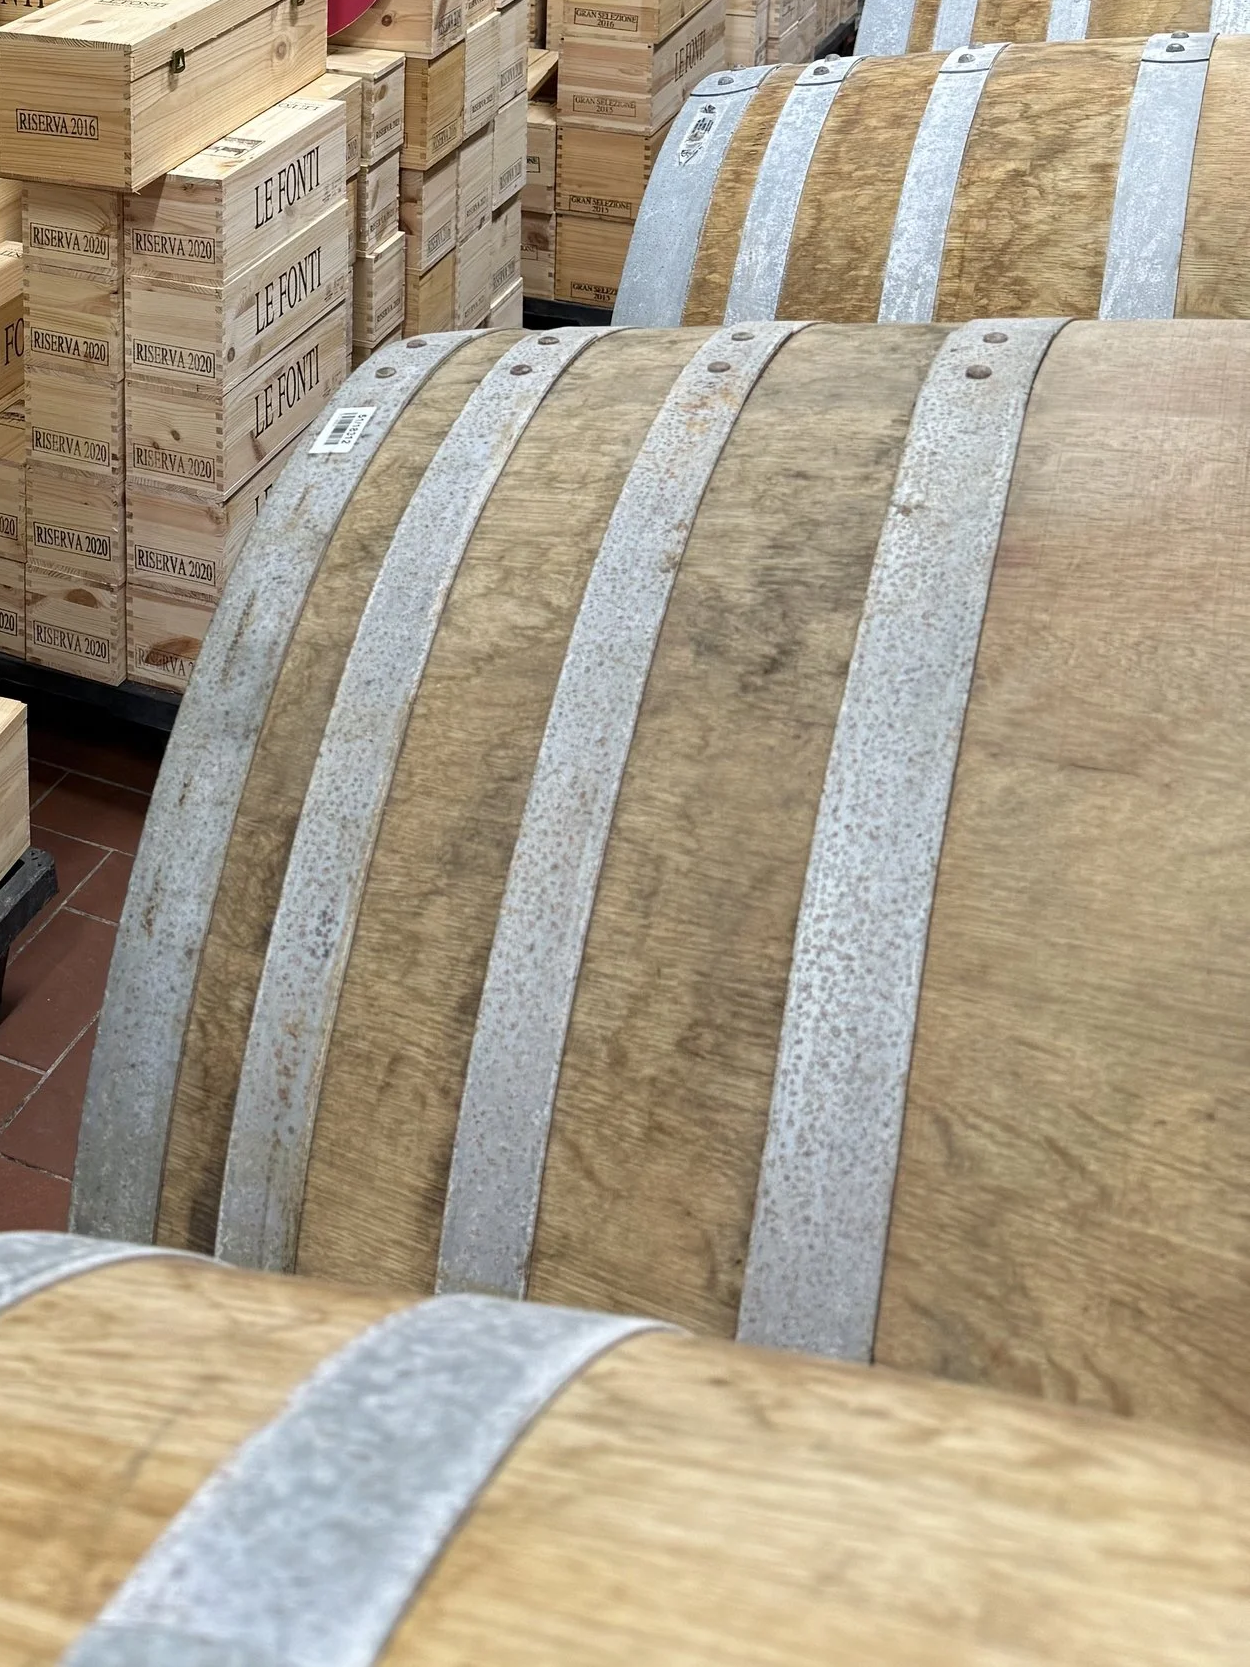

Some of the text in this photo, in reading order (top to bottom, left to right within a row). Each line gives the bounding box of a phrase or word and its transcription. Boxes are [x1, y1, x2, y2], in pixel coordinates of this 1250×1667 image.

[575, 8, 638, 24] GRAN SELEZIONE
[597, 20, 615, 29] 2016
[674, 29, 706, 83] LE FONTI
[19, 112, 96, 137] RISERVA 2016
[254, 146, 320, 229] LE FONTI
[571, 196, 631, 210] GRAN SELEZIONE
[33, 226, 107, 256] RISERVA 2020
[135, 233, 213, 260] RISERVA 2020
[254, 246, 322, 335] LE FONTI
[34, 330, 81, 357] RISERVA
[83, 342, 106, 362] 2020
[137, 342, 213, 374] RISERVA 2020
[254, 344, 320, 439] LE FONTI
[35, 430, 107, 464] RISERVA 2020
[136, 447, 213, 479] RISERVA 2020
[36, 525, 108, 557] RISERVA 2020
[138, 549, 214, 582] RISERVA 2020
[35, 625, 107, 659] RISERVA 2020
